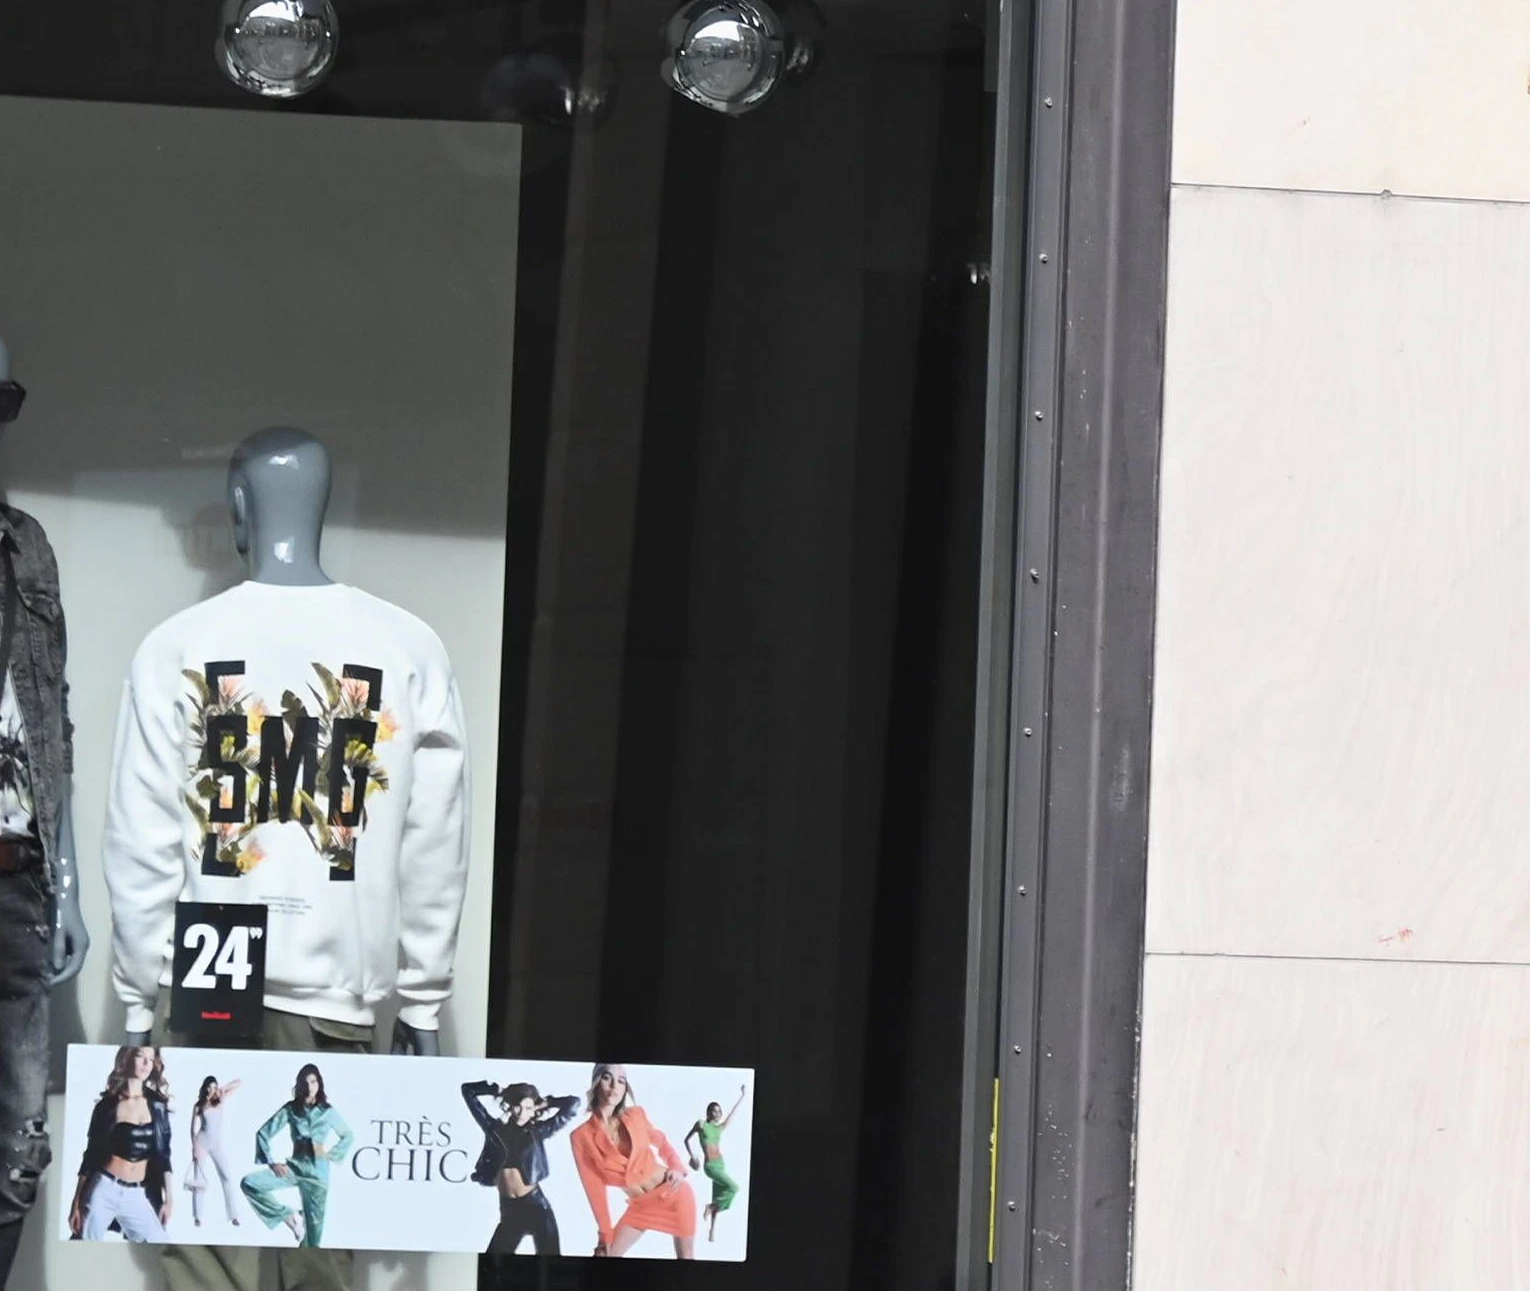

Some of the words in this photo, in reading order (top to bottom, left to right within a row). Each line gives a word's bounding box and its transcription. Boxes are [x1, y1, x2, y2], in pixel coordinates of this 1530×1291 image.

[205, 714, 377, 827] SMG
[370, 1115, 452, 1147] TRÈS
[352, 1146, 468, 1184] CHIC
